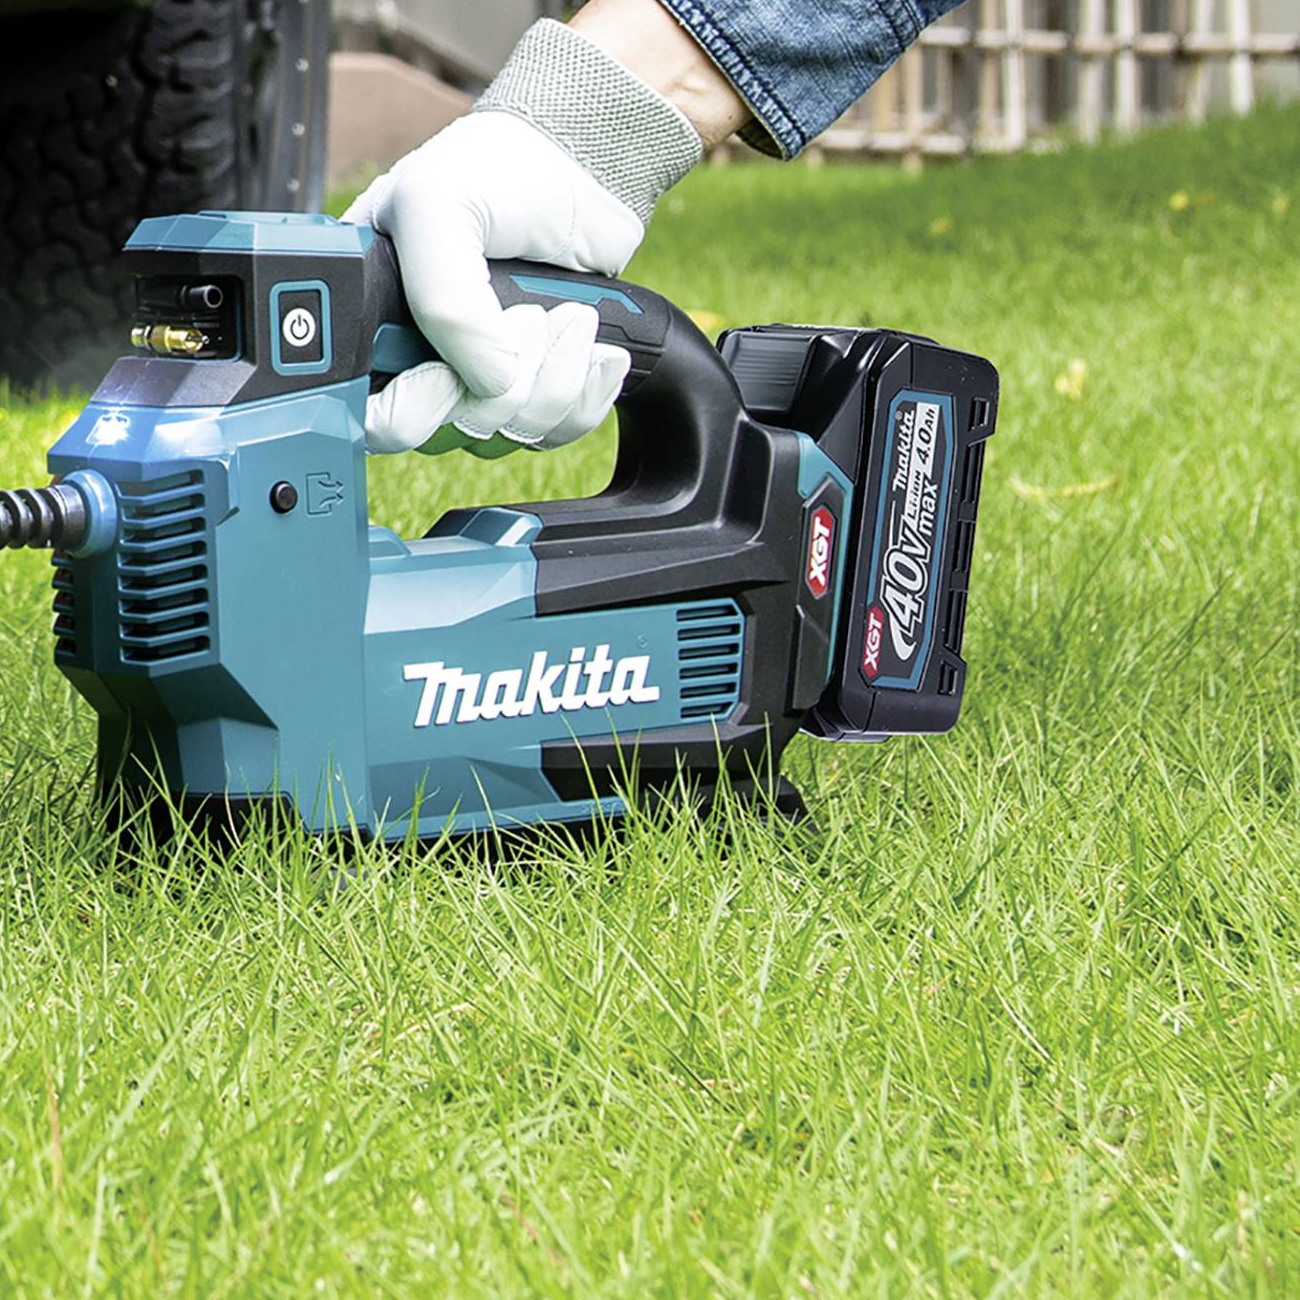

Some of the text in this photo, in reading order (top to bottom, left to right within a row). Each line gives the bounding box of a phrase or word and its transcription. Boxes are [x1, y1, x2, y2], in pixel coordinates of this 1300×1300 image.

[918, 481, 939, 537] max
[808, 515, 831, 587] XGT
[862, 612, 885, 671] XGT
